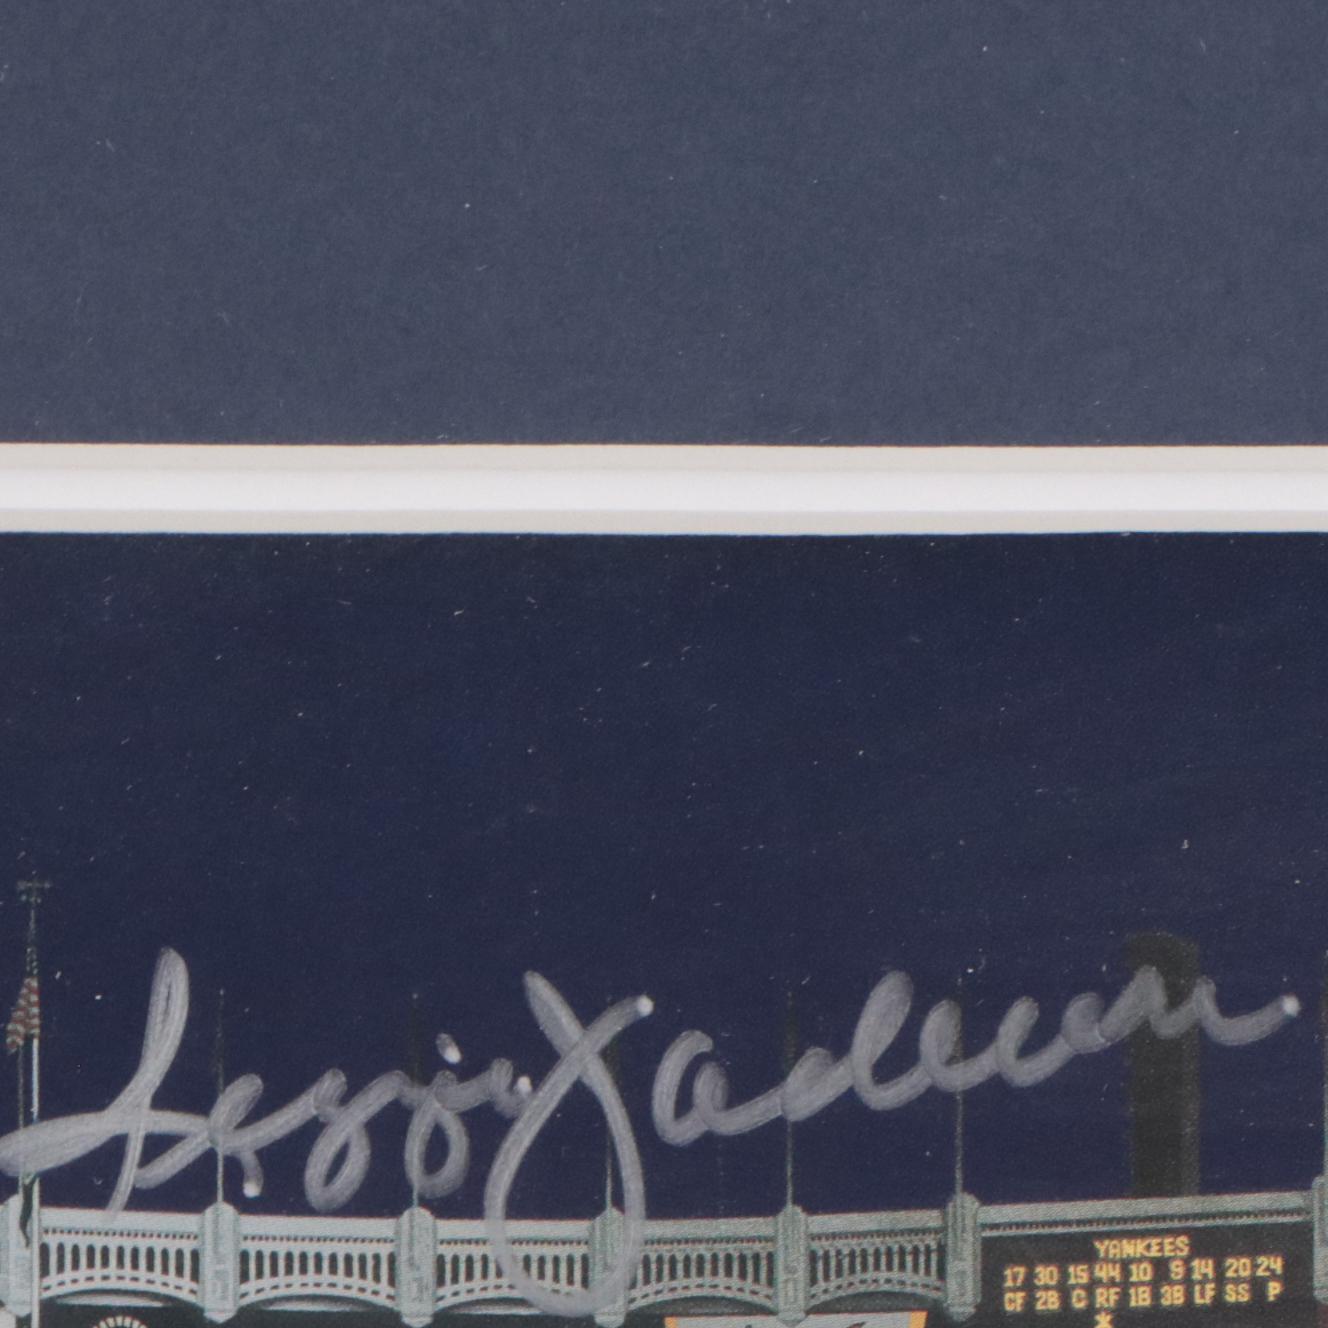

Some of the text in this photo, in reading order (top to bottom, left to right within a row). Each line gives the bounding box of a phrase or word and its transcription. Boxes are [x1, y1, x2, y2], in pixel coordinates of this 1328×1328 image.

[1093, 1236, 1190, 1259] YANKEES
[1003, 1265, 1027, 1288] 17
[1033, 1264, 1060, 1287] 30
[1067, 1263, 1090, 1285] 15
[1094, 1261, 1122, 1283] 44
[1128, 1260, 1153, 1282] 10
[1191, 1257, 1216, 1281] 14
[1224, 1257, 1252, 1278] 20
[1255, 1255, 1285, 1277] 24
[1003, 1290, 1027, 1312] CF
[1034, 1289, 1060, 1311] 2B
[1094, 1285, 1122, 1309] RF
[1128, 1285, 1153, 1307] 1B
[1160, 1284, 1186, 1306] 3B
[1193, 1282, 1216, 1305] LF
[1224, 1282, 1251, 1304] SS
[1267, 1280, 1284, 1302] P
